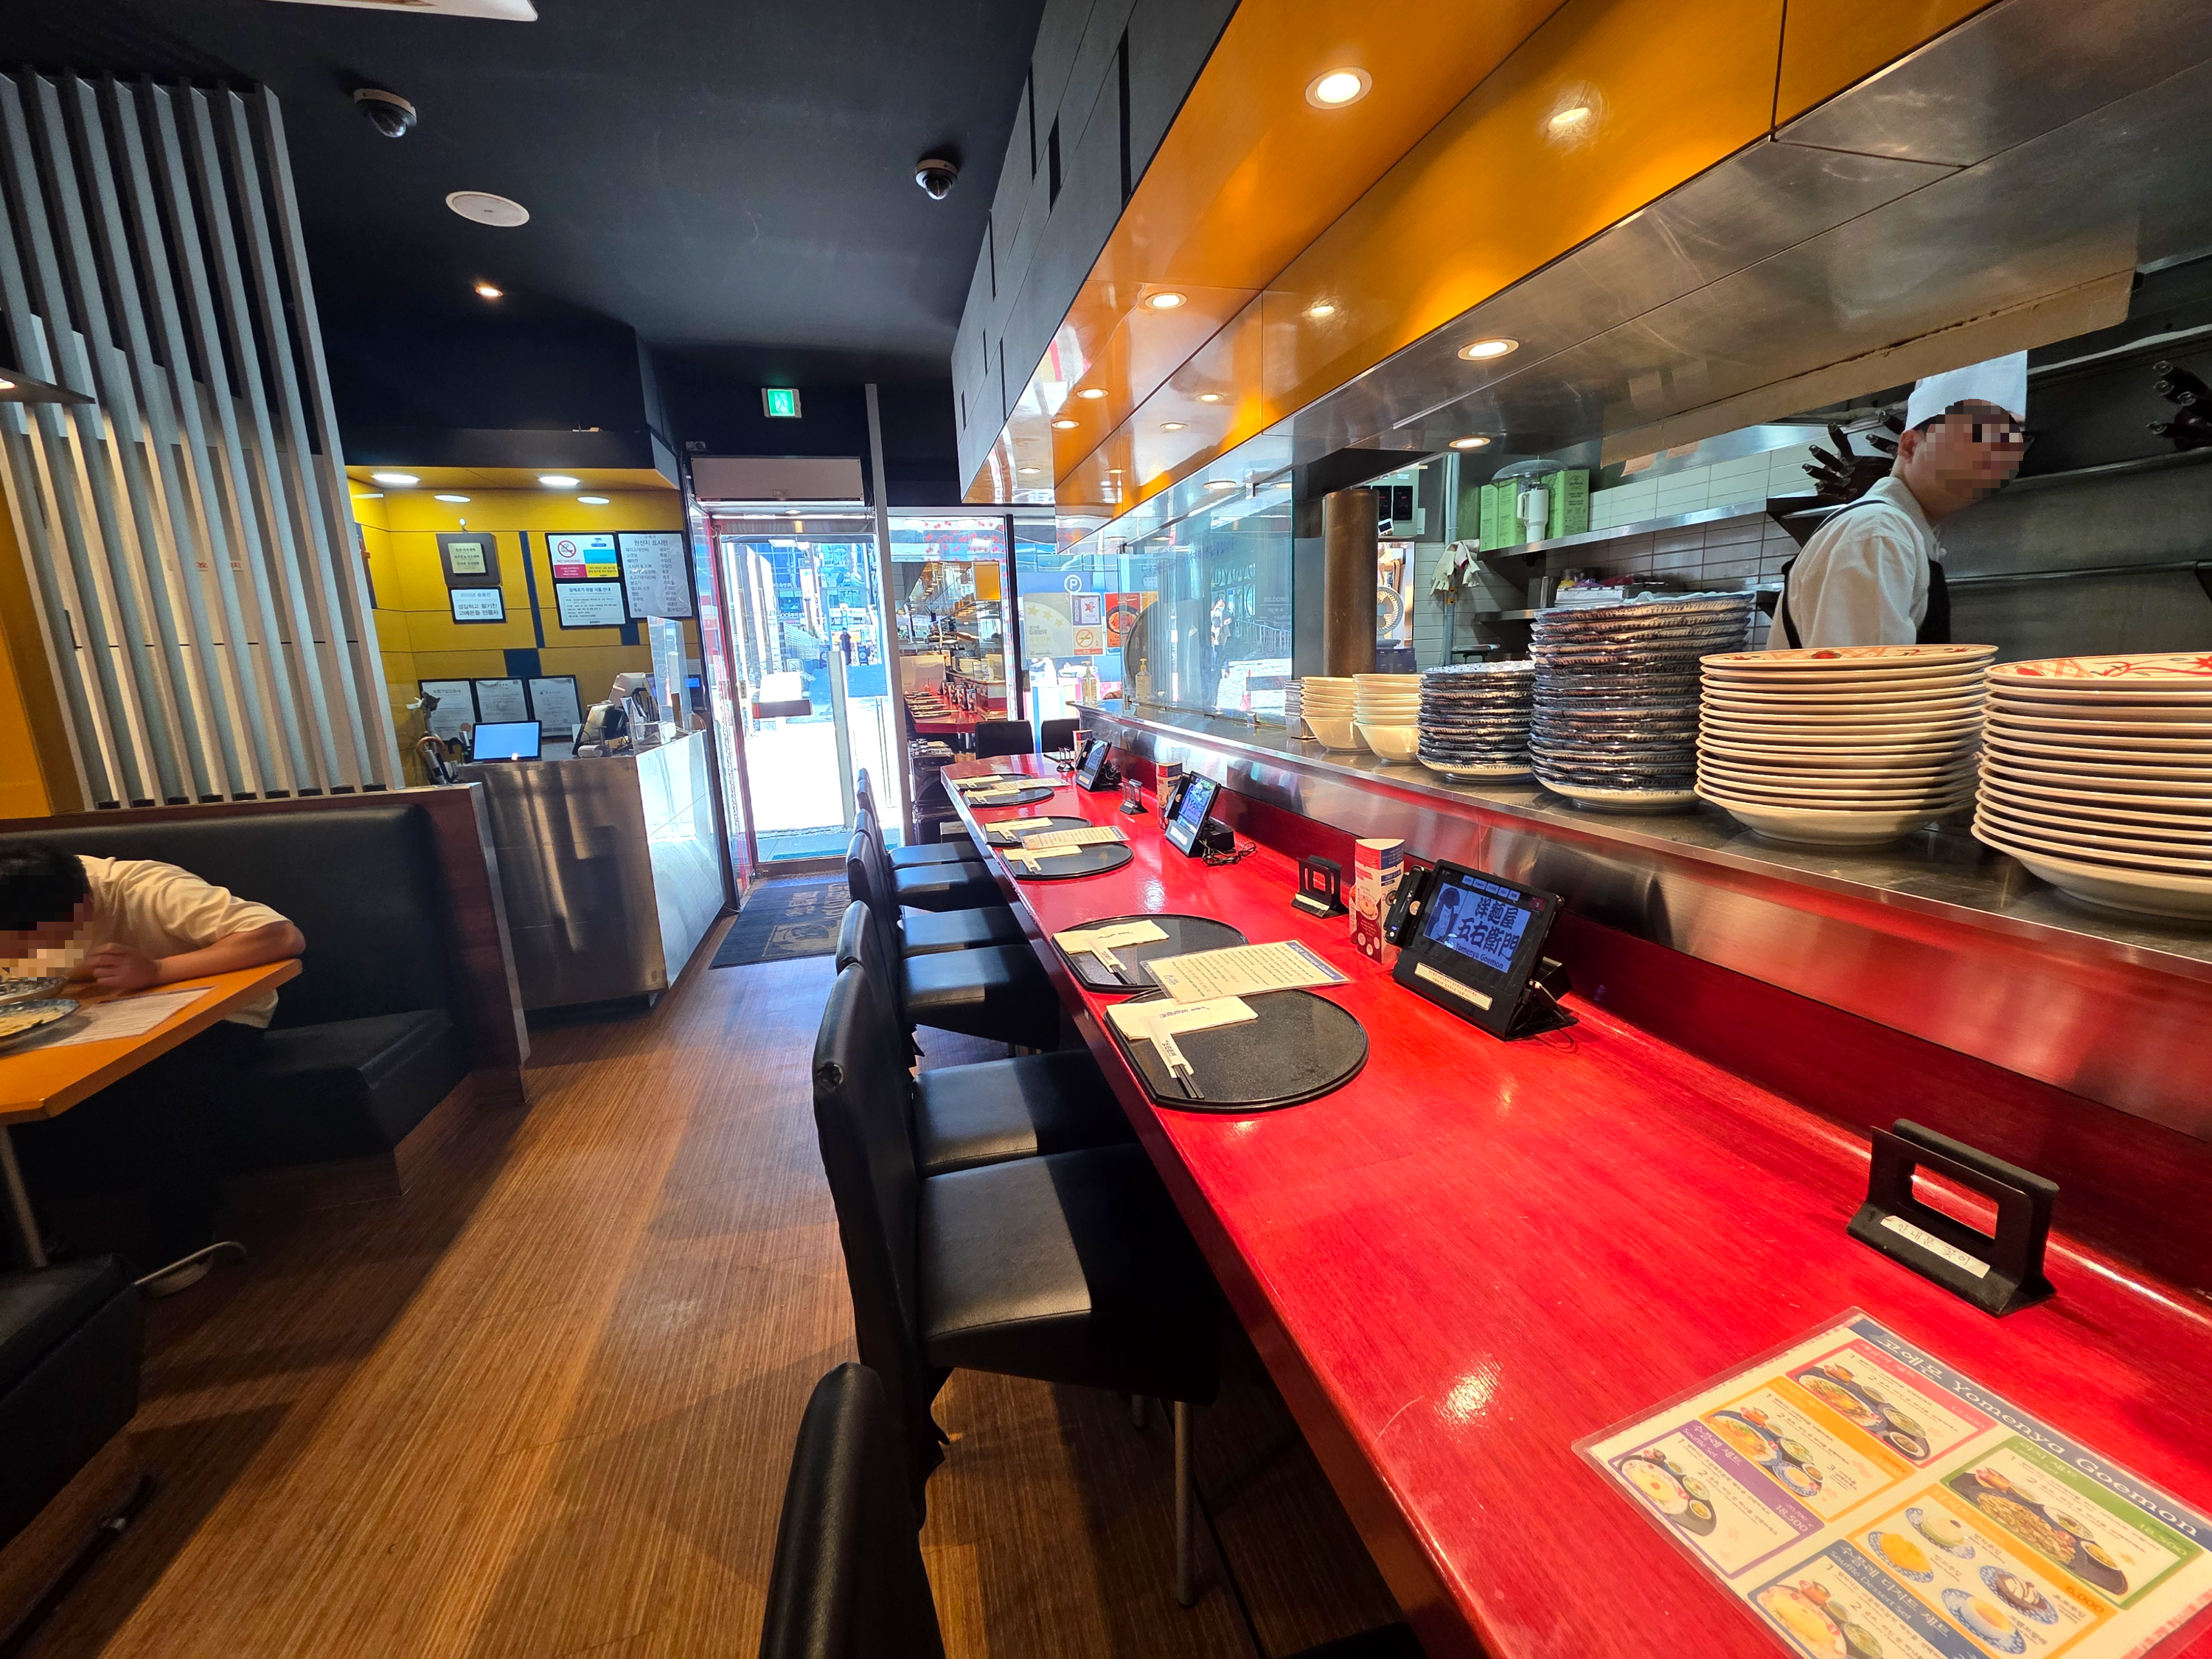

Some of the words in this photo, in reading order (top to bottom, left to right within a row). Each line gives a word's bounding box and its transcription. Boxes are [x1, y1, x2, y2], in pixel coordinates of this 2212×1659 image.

[1455, 942, 1479, 959] Yomenya
[1481, 954, 1503, 970] Goemon
[1457, 917, 1520, 961] 五右衛門
[1898, 1223, 1935, 1248] 안내문
[1943, 1245, 1972, 1267] 꽂이
[1680, 1427, 1708, 1448] Soufflé
[1703, 1446, 1719, 1458] Set
[1688, 1422, 1724, 1449] 수플레
[1718, 1447, 1746, 1467] 세트
[1873, 1336, 1948, 1381] 고에몬
[1944, 1380, 2070, 1455] Yomenya
[2072, 1455, 2205, 1537] Goemon
[2017, 1441, 2048, 1460] 라지
[2049, 1461, 2081, 1481] 세트
[1771, 1503, 1810, 1533] 18,500
[1930, 1489, 1975, 1520] 디저트
[1970, 1519, 2007, 1544] Dessert
[2136, 1523, 2190, 1557] 18,500
[1827, 1550, 1863, 1578] Soufflé
[1858, 1575, 1897, 1606] Dessert
[1893, 1604, 1914, 1621] Set
[1834, 1543, 1881, 1579] 수플레
[1877, 1577, 1923, 1613] 디저트
[1917, 1610, 1954, 1638] 세트
[1849, 1601, 1864, 1612] 2
[2063, 1585, 2106, 1614] 6,000
